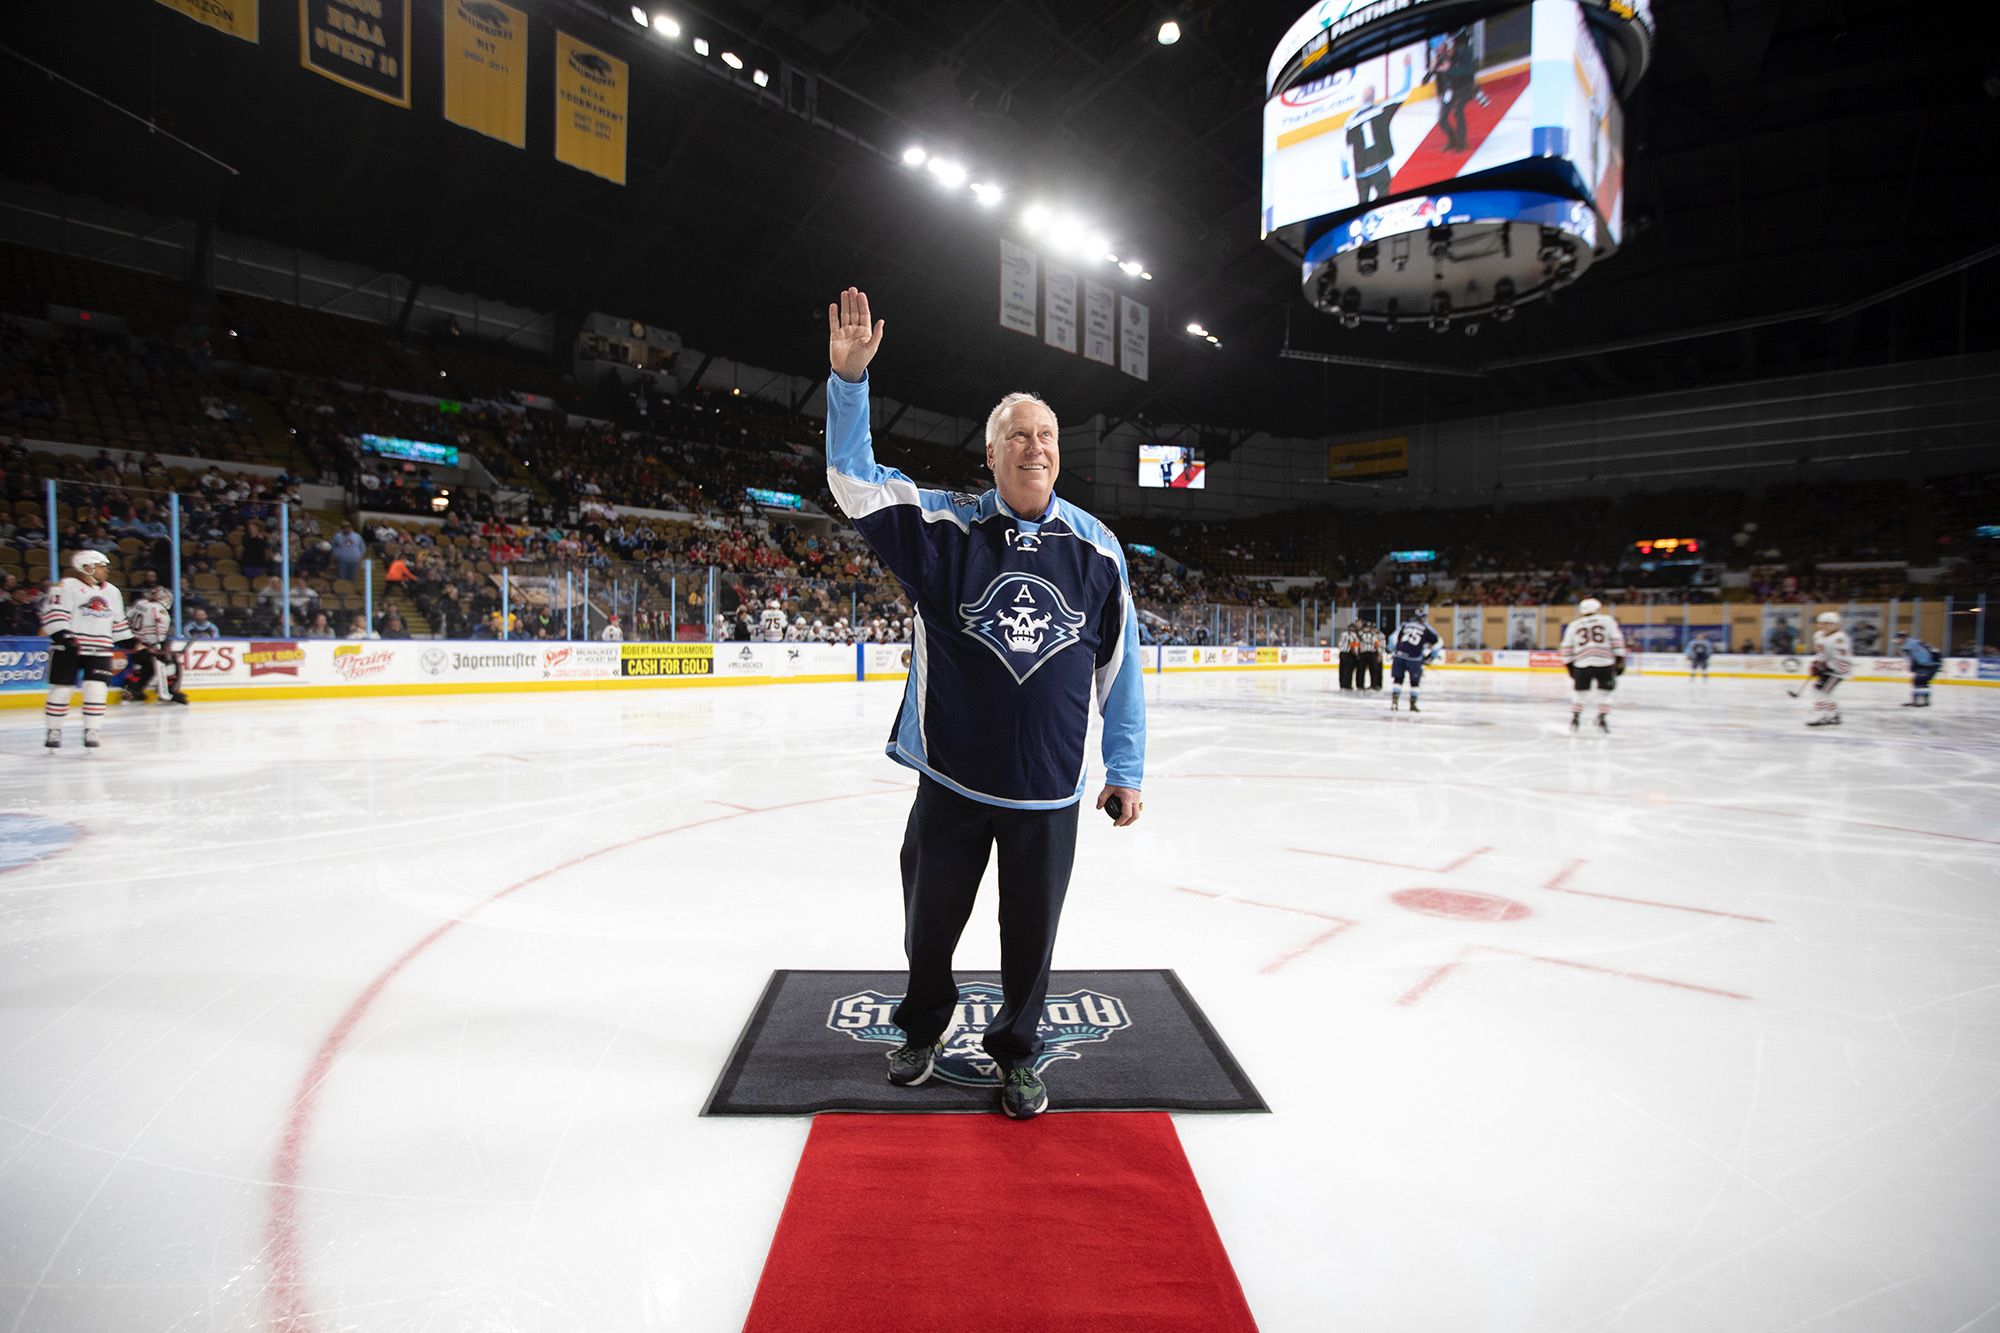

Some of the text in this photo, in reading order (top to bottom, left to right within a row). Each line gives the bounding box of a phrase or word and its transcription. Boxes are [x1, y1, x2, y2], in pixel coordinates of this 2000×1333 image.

[327, 5, 386, 47] NCAA
[315, 27, 374, 68] SWEET
[477, 37, 496, 54] NIT
[560, 90, 624, 123] TOURNAMENT
[1014, 584, 1036, 604] A
[765, 617, 781, 631] 75
[1576, 625, 1604, 647] 36
[622, 645, 713, 655] ROBERT HAACK DIAMONDS
[628, 659, 658, 676] CASH
[660, 659, 680, 675] FOR
[682, 658, 709, 675] GOLD
